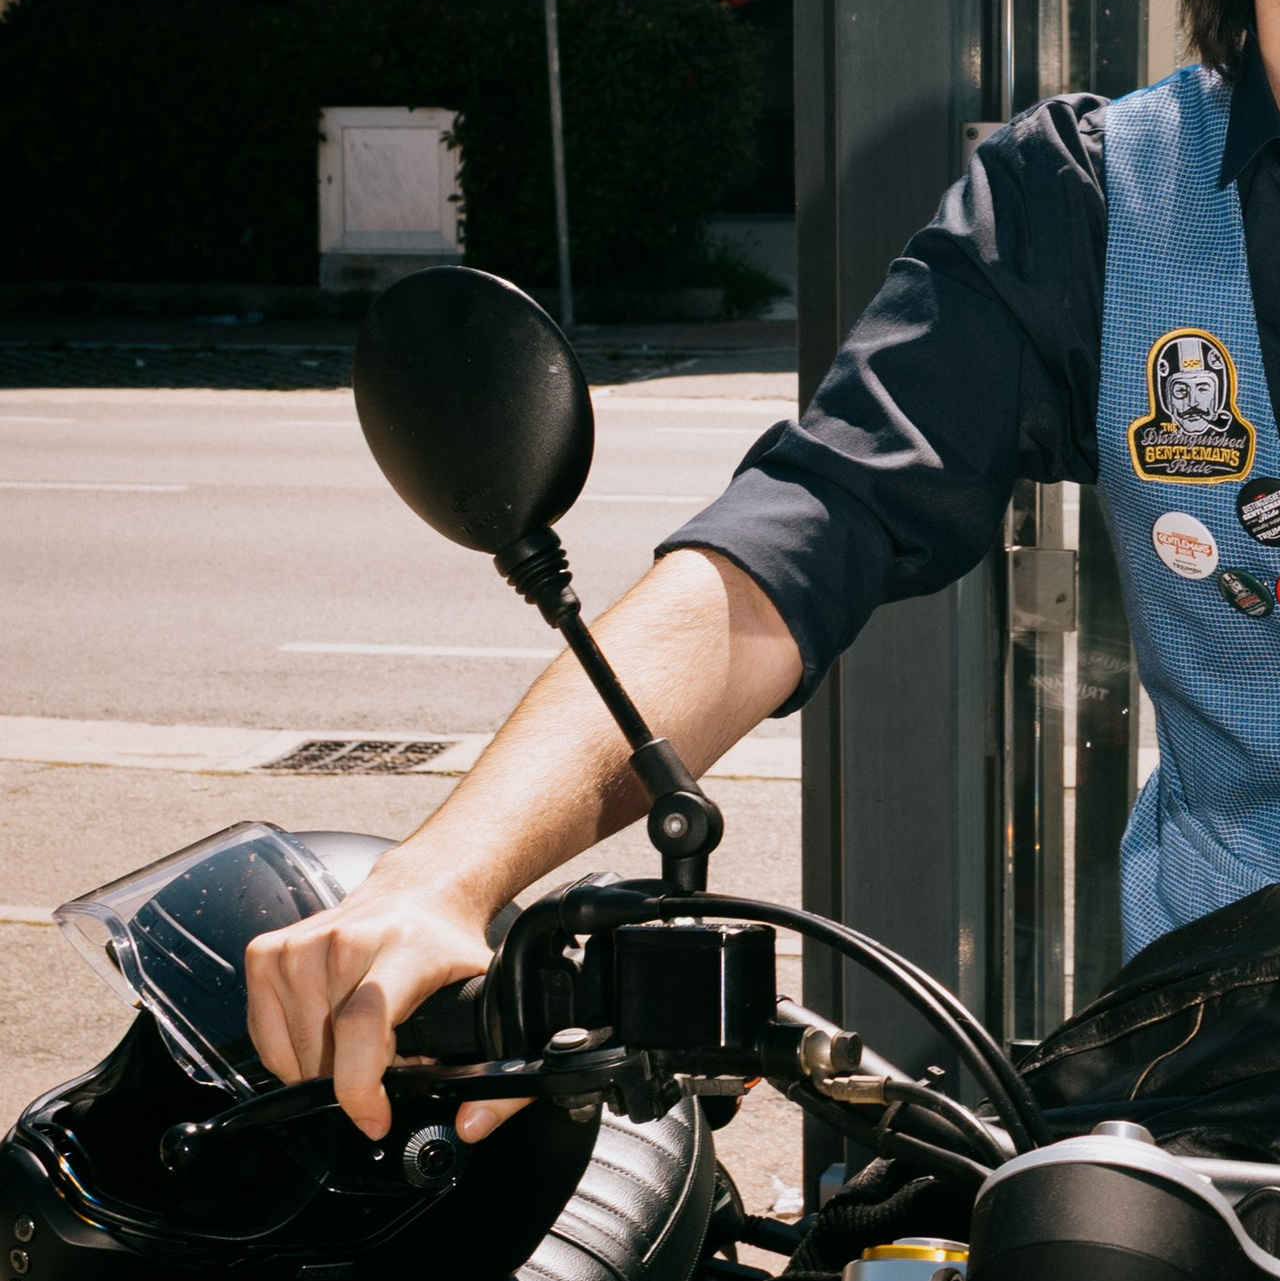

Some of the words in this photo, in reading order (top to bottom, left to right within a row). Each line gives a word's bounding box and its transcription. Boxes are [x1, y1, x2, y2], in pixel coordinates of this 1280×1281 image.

[1160, 422, 1178, 434] THE
[1141, 427, 1246, 450] Distinguished
[1166, 459, 1213, 474] Ride
